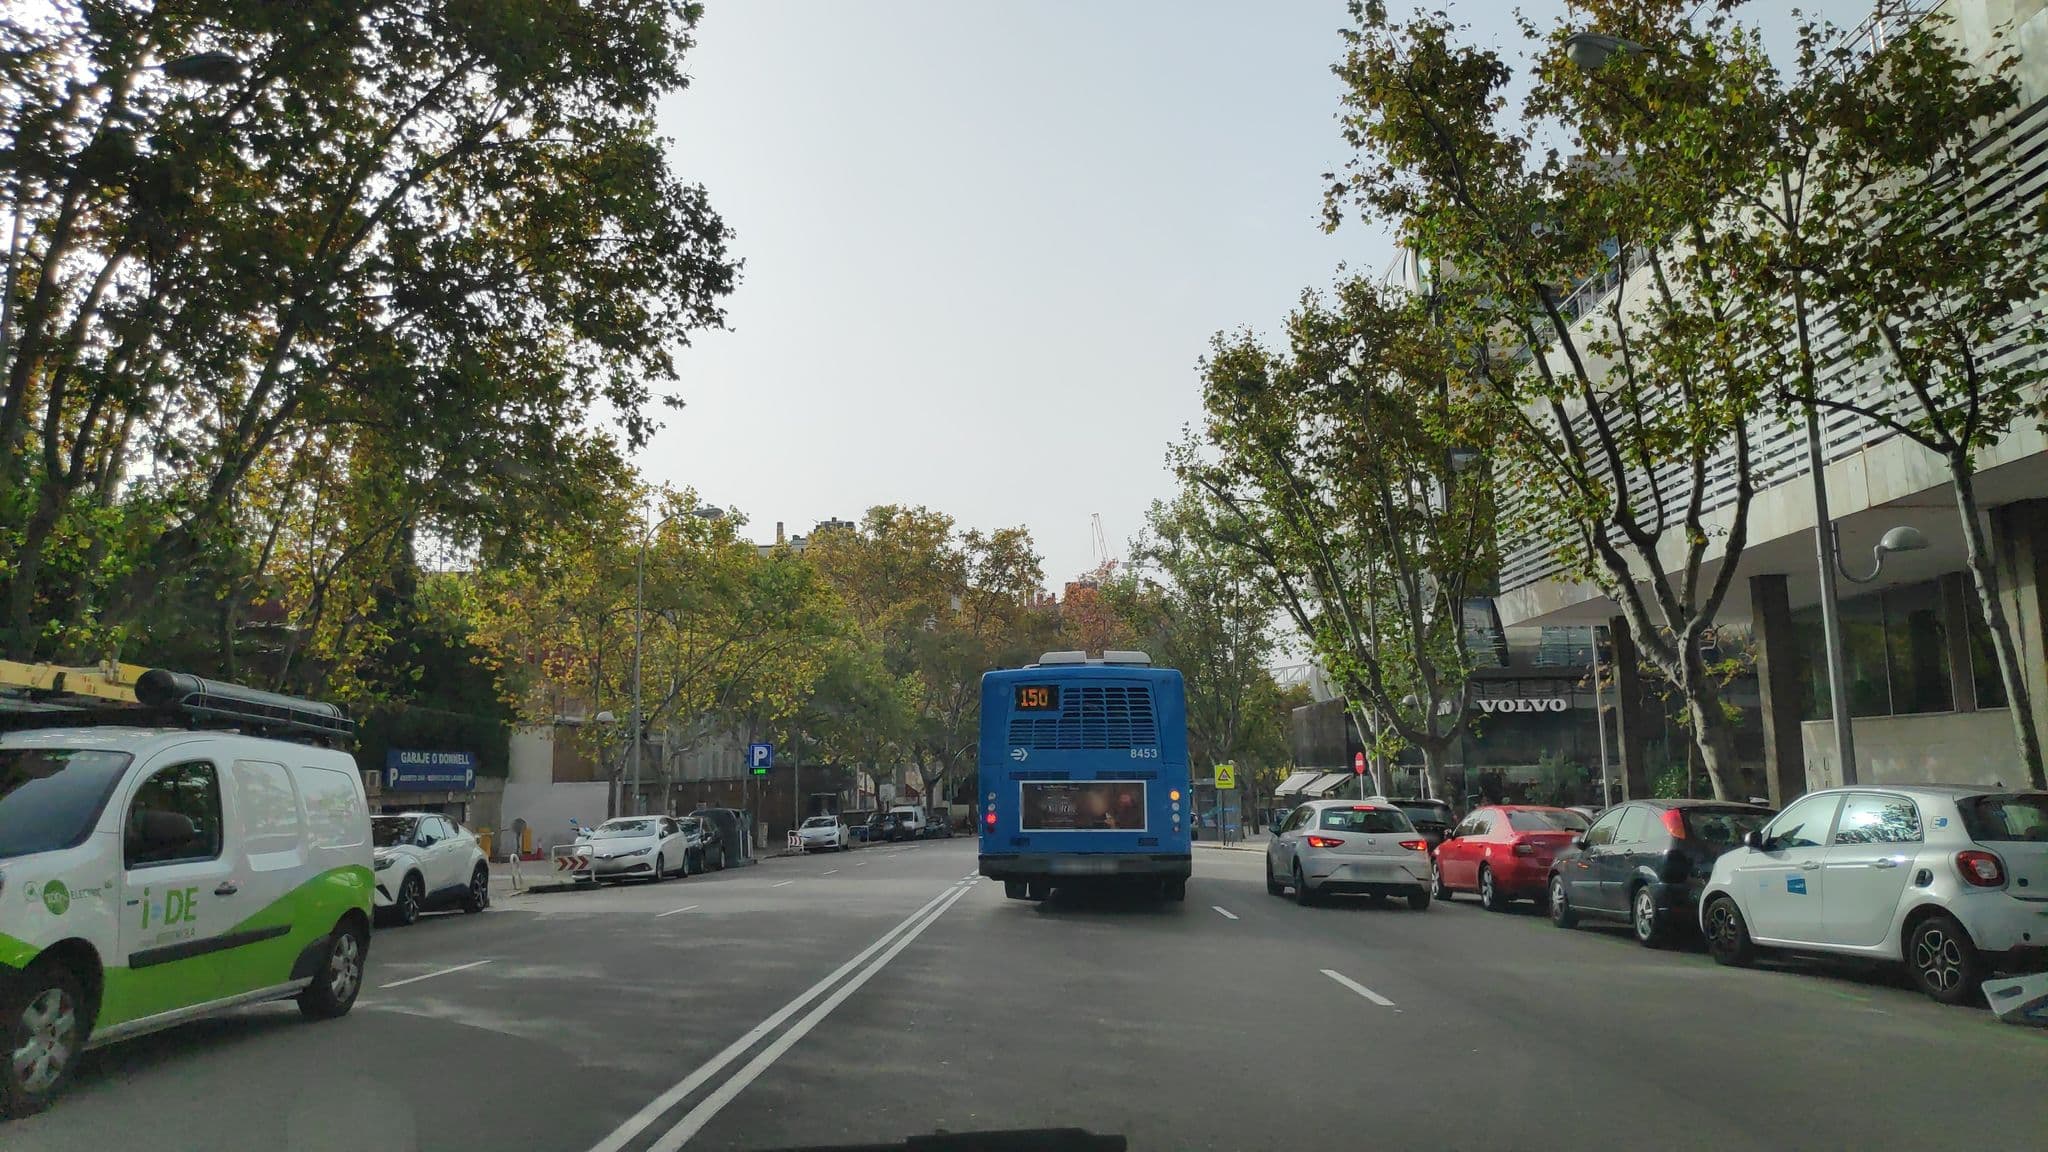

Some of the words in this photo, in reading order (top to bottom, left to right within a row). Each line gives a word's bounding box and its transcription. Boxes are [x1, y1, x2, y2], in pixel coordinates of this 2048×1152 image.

[1021, 687, 1048, 707] 150
[1476, 698, 1567, 713] VOLVO
[400, 752, 430, 764] GARAJE
[753, 746, 768, 766] P
[1130, 748, 1158, 759] 8453
